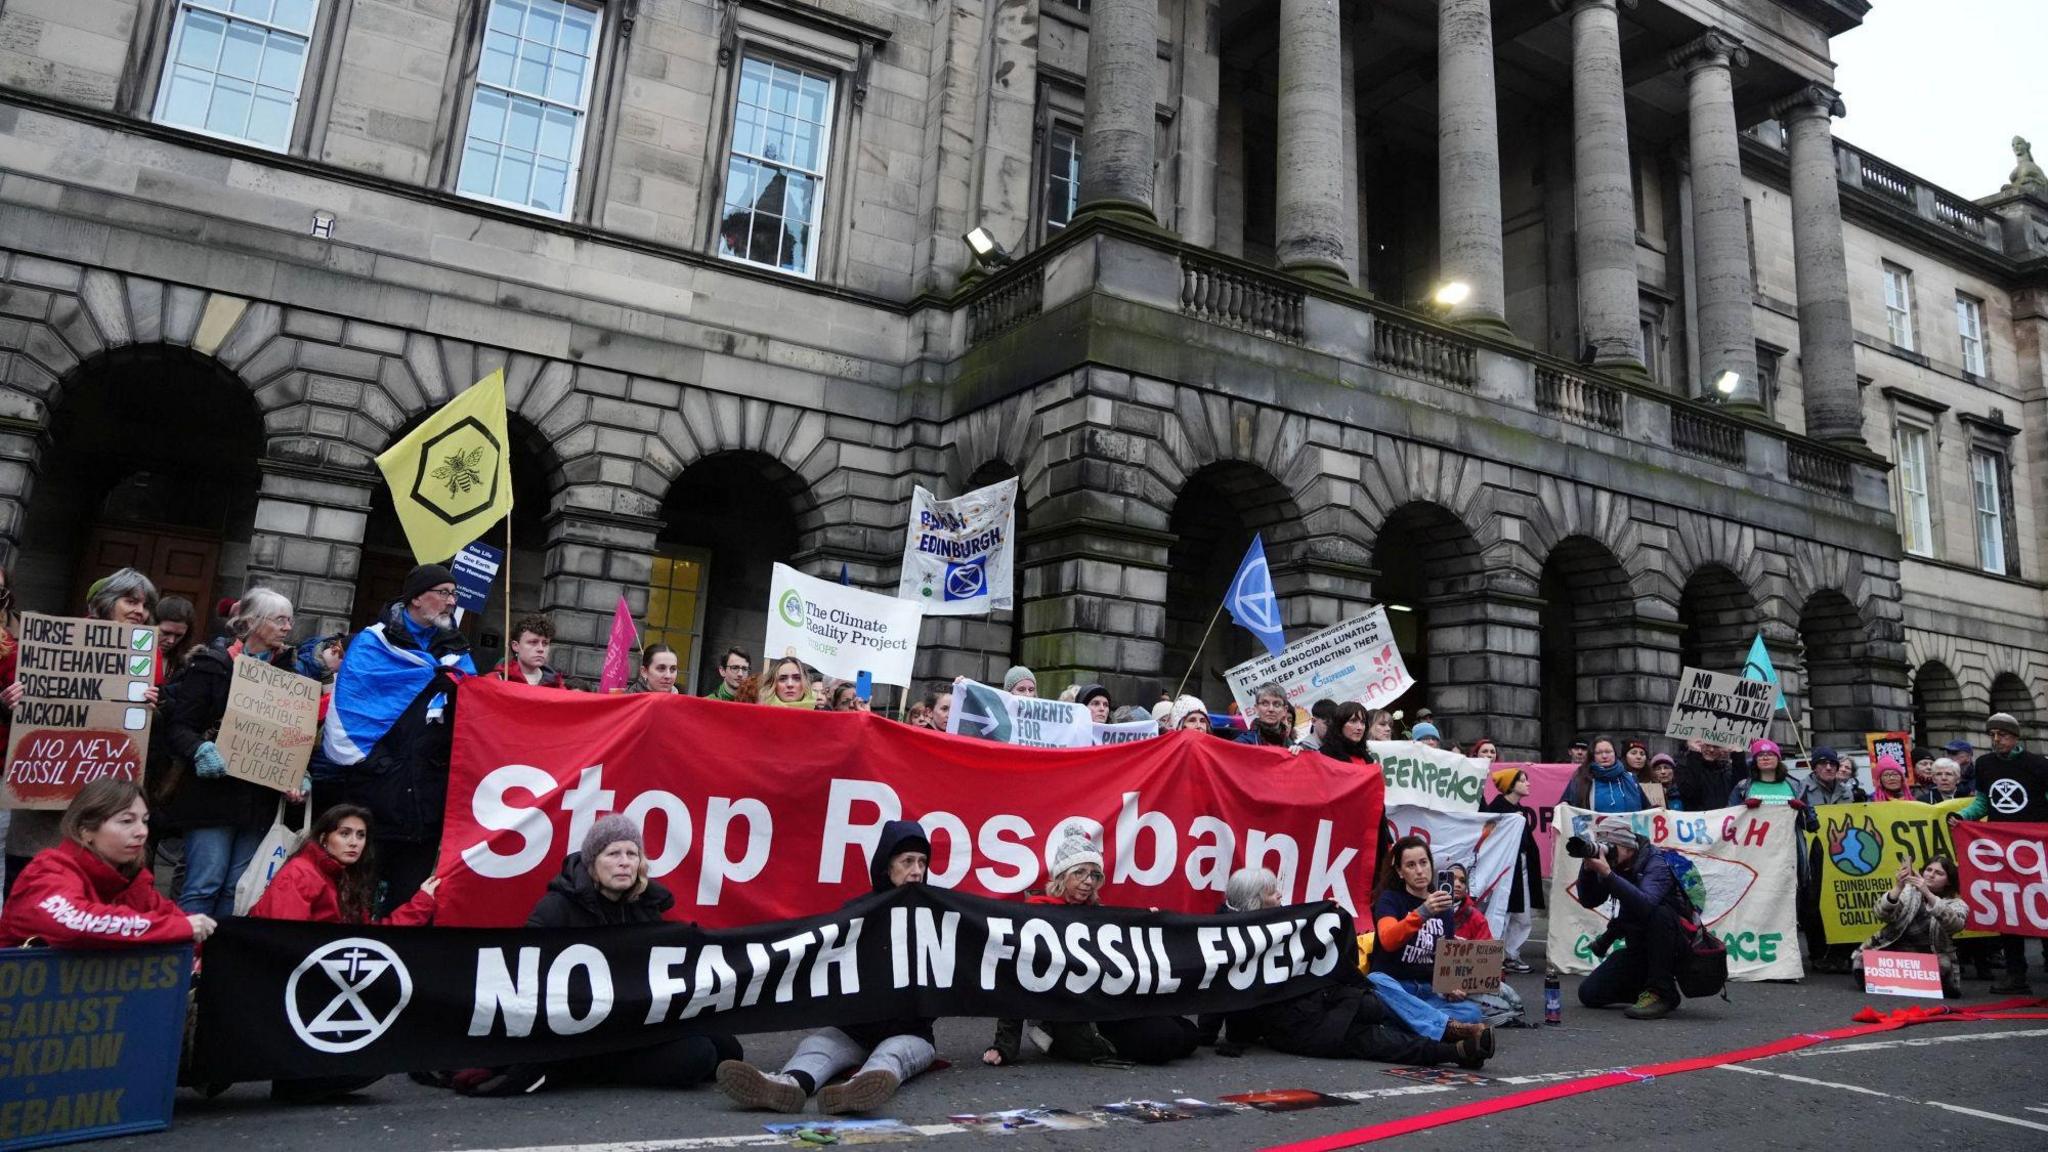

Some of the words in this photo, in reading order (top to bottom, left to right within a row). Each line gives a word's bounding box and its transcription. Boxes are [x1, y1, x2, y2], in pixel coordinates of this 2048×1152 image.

[470, 546, 480, 555] One
[919, 527, 1001, 558] EDINBURGH
[454, 564, 466, 572] One
[466, 569, 493, 583] Humanity
[463, 555, 473, 563] One
[476, 560, 491, 569] Earth
[806, 601, 827, 619] The
[830, 609, 887, 633] Climate
[23, 617, 75, 646] HORSE
[85, 624, 128, 649] HILL
[806, 617, 848, 644] Reality
[851, 630, 907, 651] Project
[1290, 643, 1304, 653] NOT
[1305, 636, 1319, 646] OUR
[1321, 624, 1346, 640] BIGGEST
[20, 645, 127, 675] WHITEHAVEN
[1239, 673, 1258, 687] IT'S
[1260, 664, 1277, 677] THE
[1279, 642, 1332, 669] GENOCIDAL
[1334, 622, 1377, 645] LUNATICS
[1273, 670, 1294, 685] KEEP
[1298, 646, 1351, 674] EXTRACTING
[1354, 634, 1379, 650] THEM
[239, 662, 259, 680] NO
[262, 670, 292, 690] NEW
[293, 682, 315, 701] OIL
[263, 689, 274, 701] IS
[1692, 672, 1713, 690] NO
[1734, 681, 1772, 701] MORE
[16, 701, 89, 728] JACKDAW
[233, 692, 304, 727] COMPATIBLE
[1017, 700, 1073, 724] PARENTS
[1681, 688, 1732, 712] LICENCES
[1735, 698, 1750, 714] TO
[1751, 701, 1771, 719] KILL
[234, 717, 265, 736] WITH
[1017, 719, 1041, 740] FOR
[1669, 723, 1695, 736] JUST
[1701, 727, 1747, 746] TRANSITION
[29, 738, 64, 760] NO
[69, 738, 130, 760] NEW
[230, 734, 295, 767] LIVEABLE
[7, 760, 67, 785] FOSSIL
[461, 763, 773, 906] Stop
[1834, 878, 1893, 892] EDINBURGH
[39, 894, 151, 937] GREENPEACE
[1443, 943, 1474, 957] STOP
[1878, 957, 1894, 968] NO
[1896, 959, 1921, 970] NEW
[59, 955, 180, 994] VOICES
[468, 944, 614, 1038] NO
[643, 917, 864, 1025] FAITH
[890, 906, 961, 989] IN
[980, 915, 1180, 996] FOSSIL
[1198, 912, 1342, 991] FUELS
[1440, 966, 1450, 976] NO
[1455, 966, 1474, 976] NEW
[1462, 977, 1477, 989] OIL
[1484, 976, 1500, 990] GAS
[1864, 966, 1902, 979] FOSSIL
[1903, 970, 1941, 981] FUELS!
